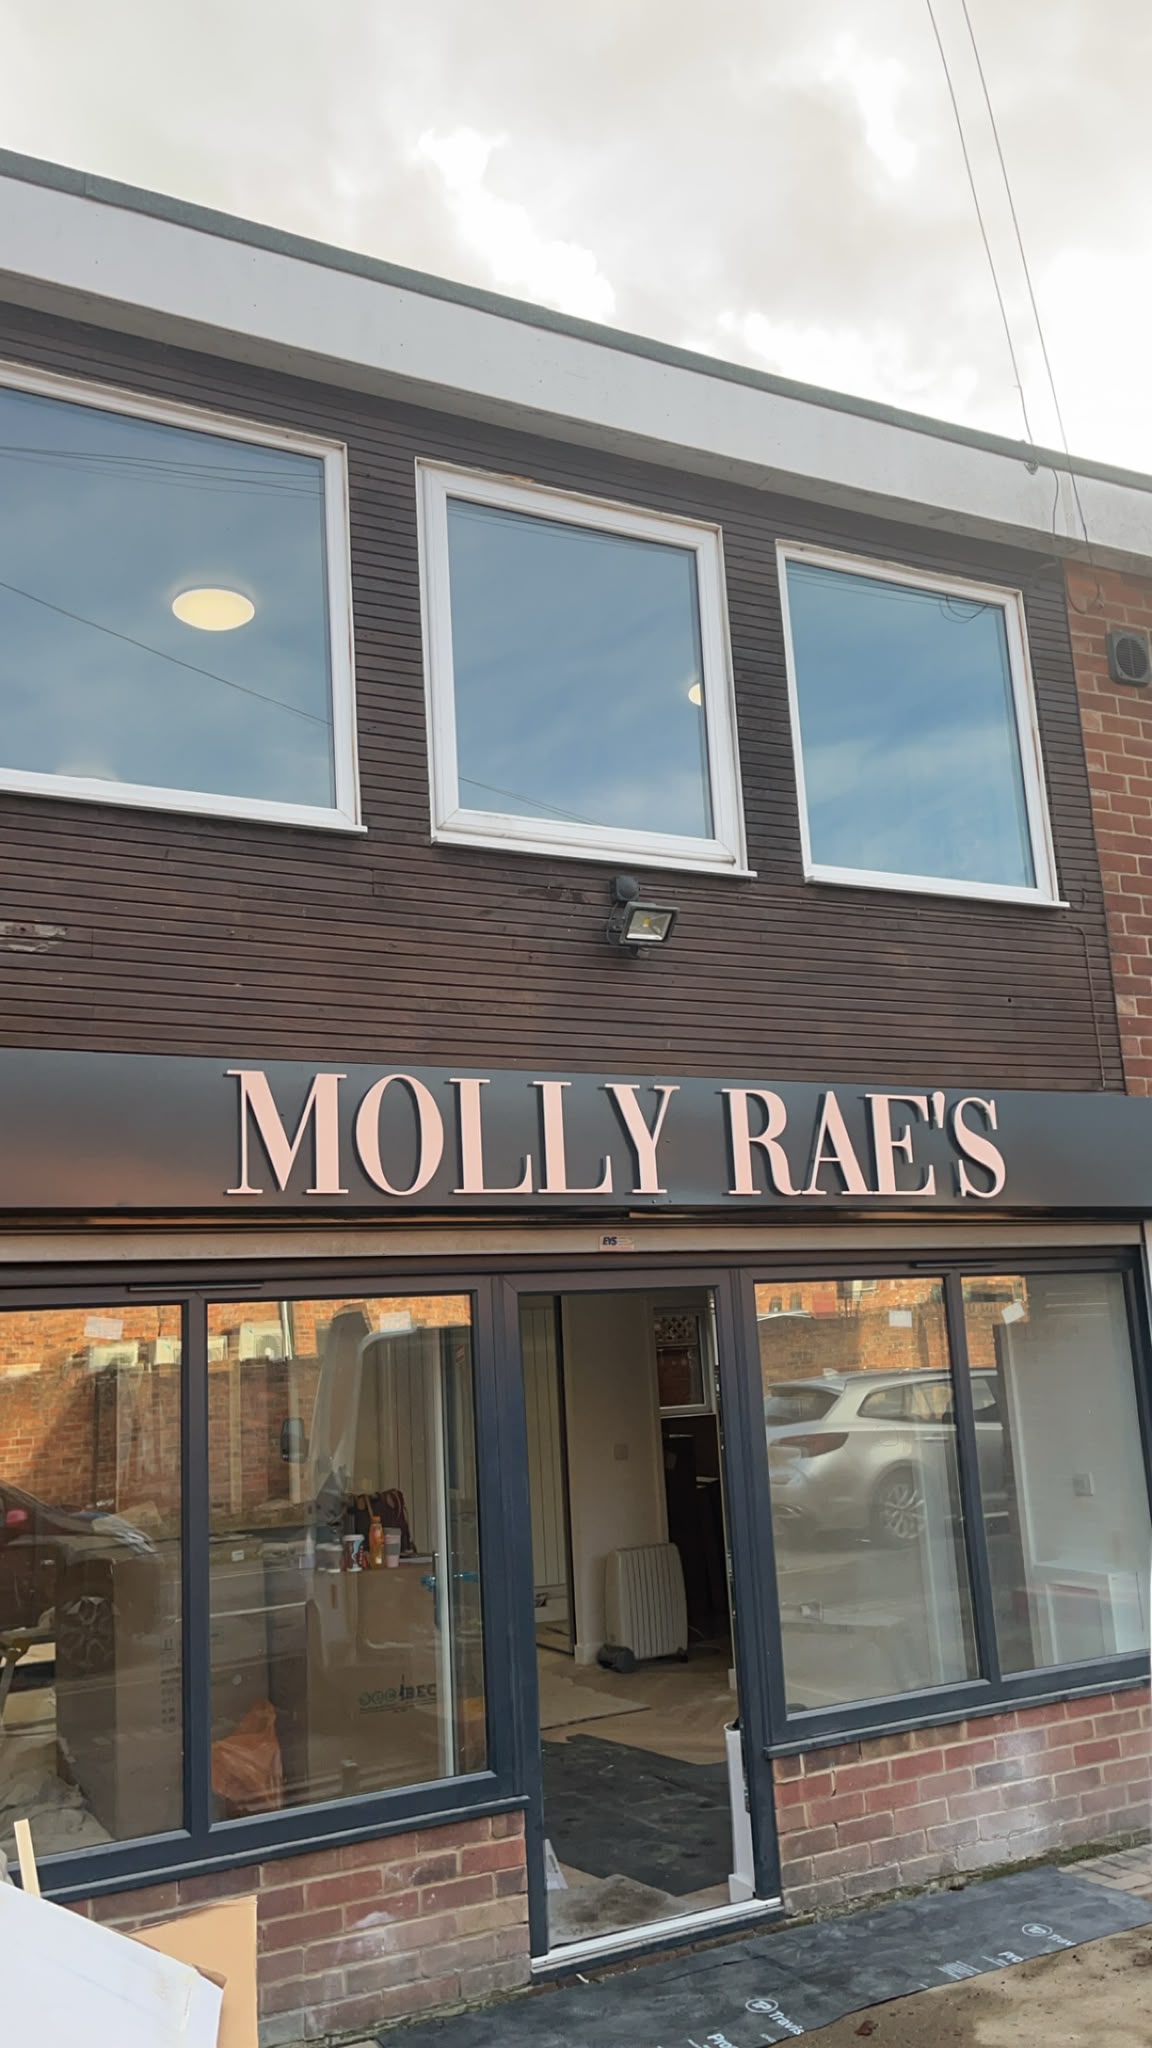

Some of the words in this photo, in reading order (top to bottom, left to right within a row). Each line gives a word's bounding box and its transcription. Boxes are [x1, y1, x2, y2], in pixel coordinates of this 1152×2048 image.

[226, 1069, 680, 1196] MOLLY
[721, 1087, 1006, 1198] RAE'S
[768, 2010, 804, 2035] Travis
[707, 2033, 740, 2048] Pro
